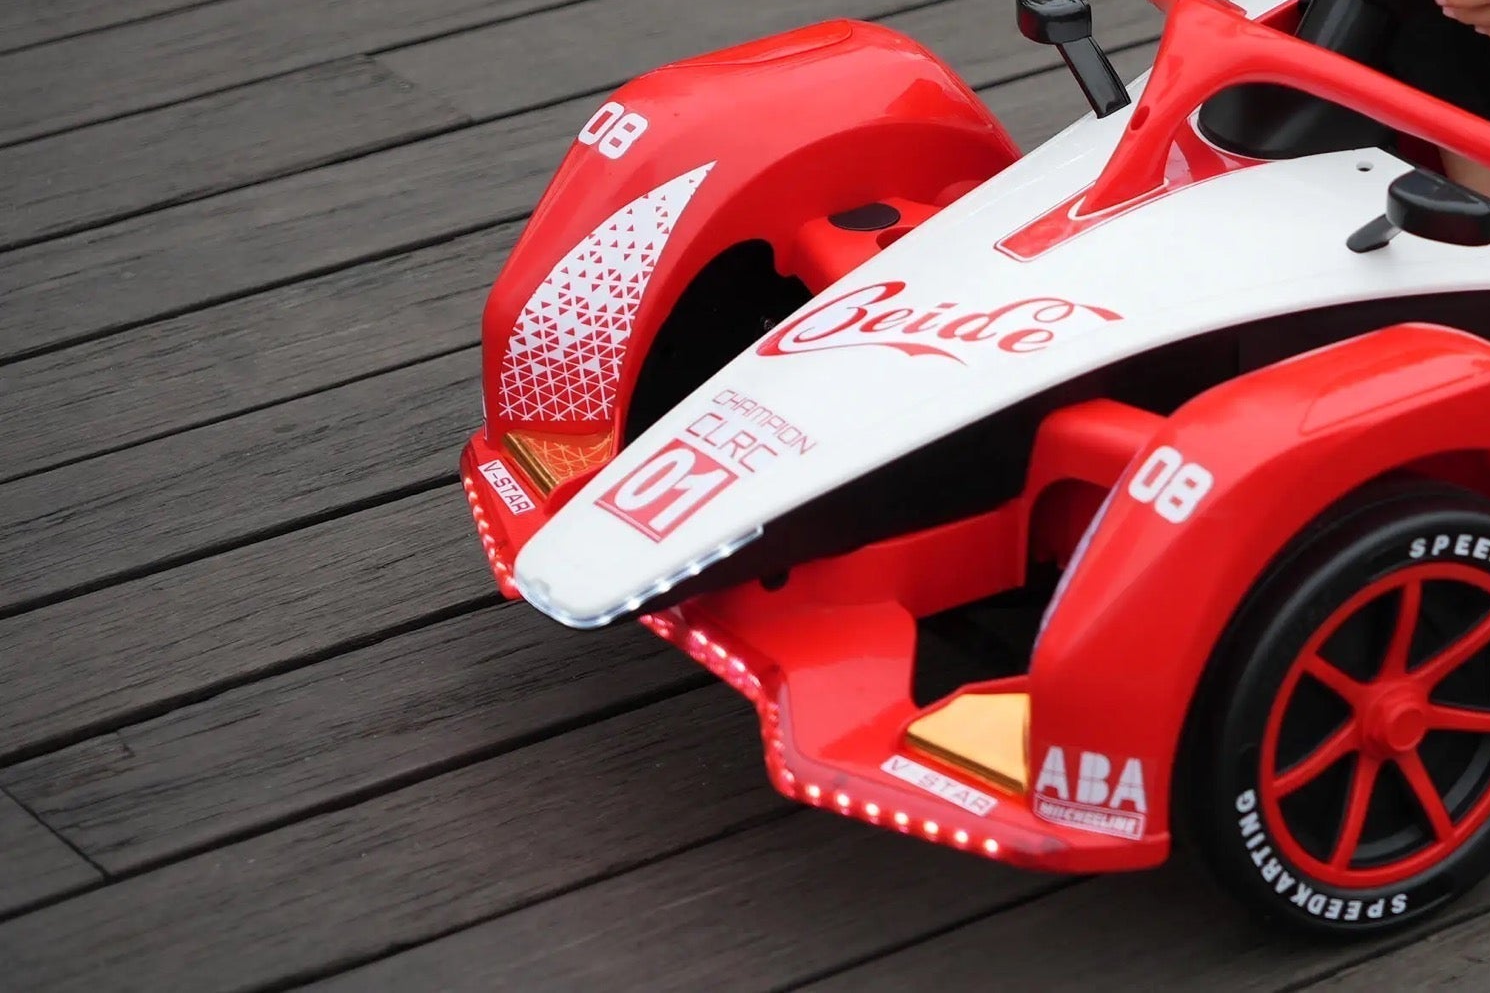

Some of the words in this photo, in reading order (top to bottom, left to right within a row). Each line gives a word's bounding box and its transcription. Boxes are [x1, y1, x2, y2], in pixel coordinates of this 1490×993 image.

[578, 102, 649, 159] 08
[755, 280, 1124, 366] Beide
[686, 412, 779, 473] CLRC
[711, 389, 819, 455] CHAMPION
[483, 461, 530, 513] V-STAR
[614, 448, 730, 531] 01
[1128, 447, 1213, 523] 08
[1035, 746, 1147, 813] ABA
[1235, 789, 1407, 921] SPEEDKARTING
